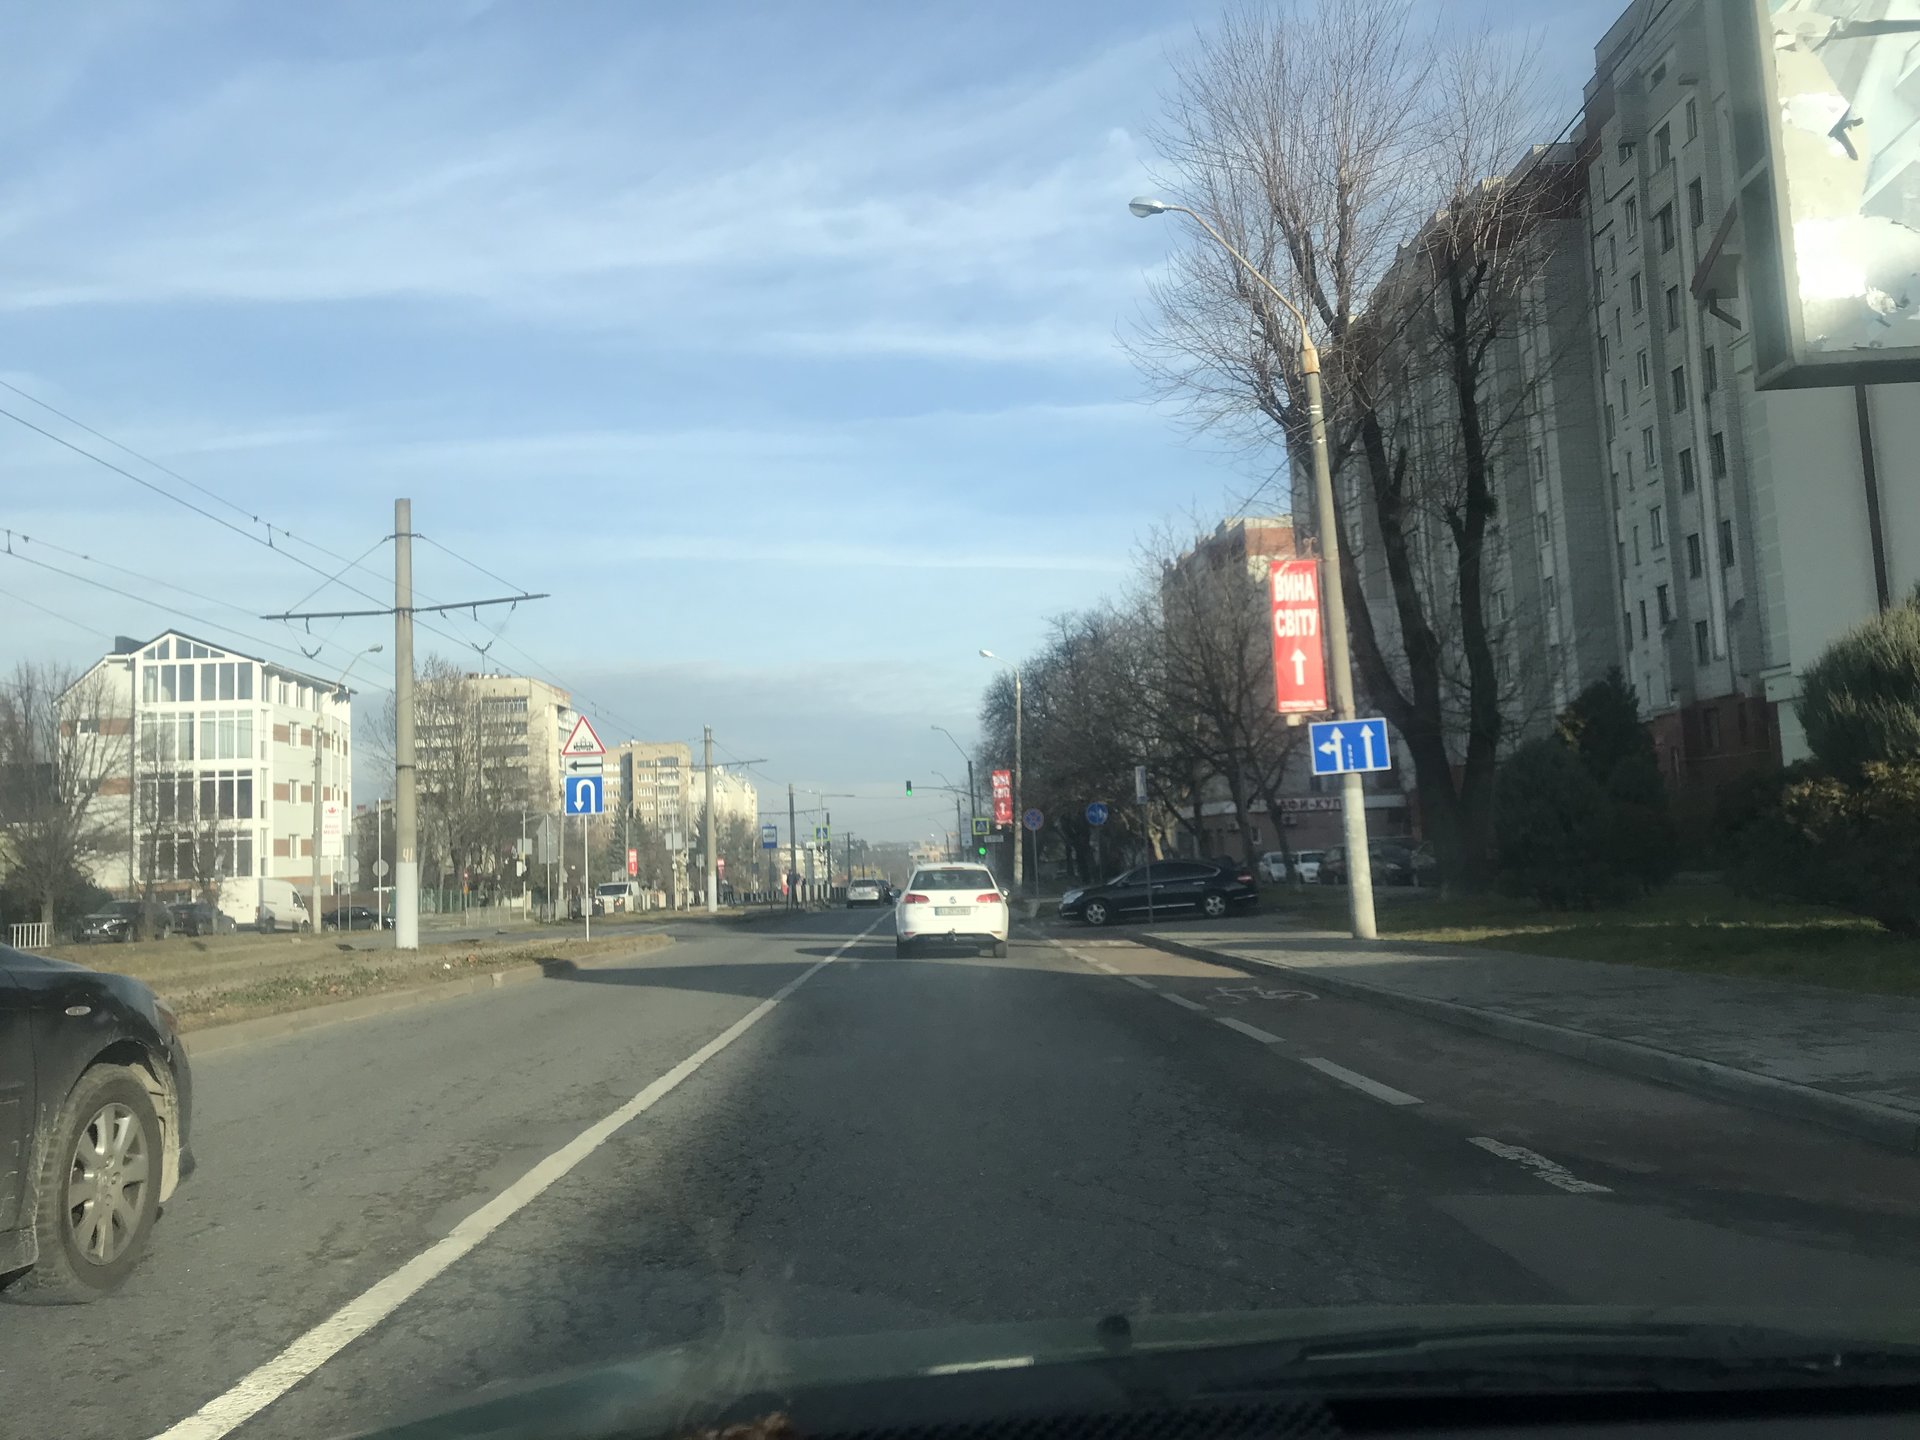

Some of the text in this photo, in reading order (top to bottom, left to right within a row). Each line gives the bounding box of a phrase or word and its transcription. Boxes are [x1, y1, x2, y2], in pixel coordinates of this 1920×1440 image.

[1275, 573, 1314, 601] ВИНА
[1275, 608, 1317, 637] СВІТУ
[1281, 798, 1341, 812] АФИ-КУП
[402, 847, 413, 863] 41
